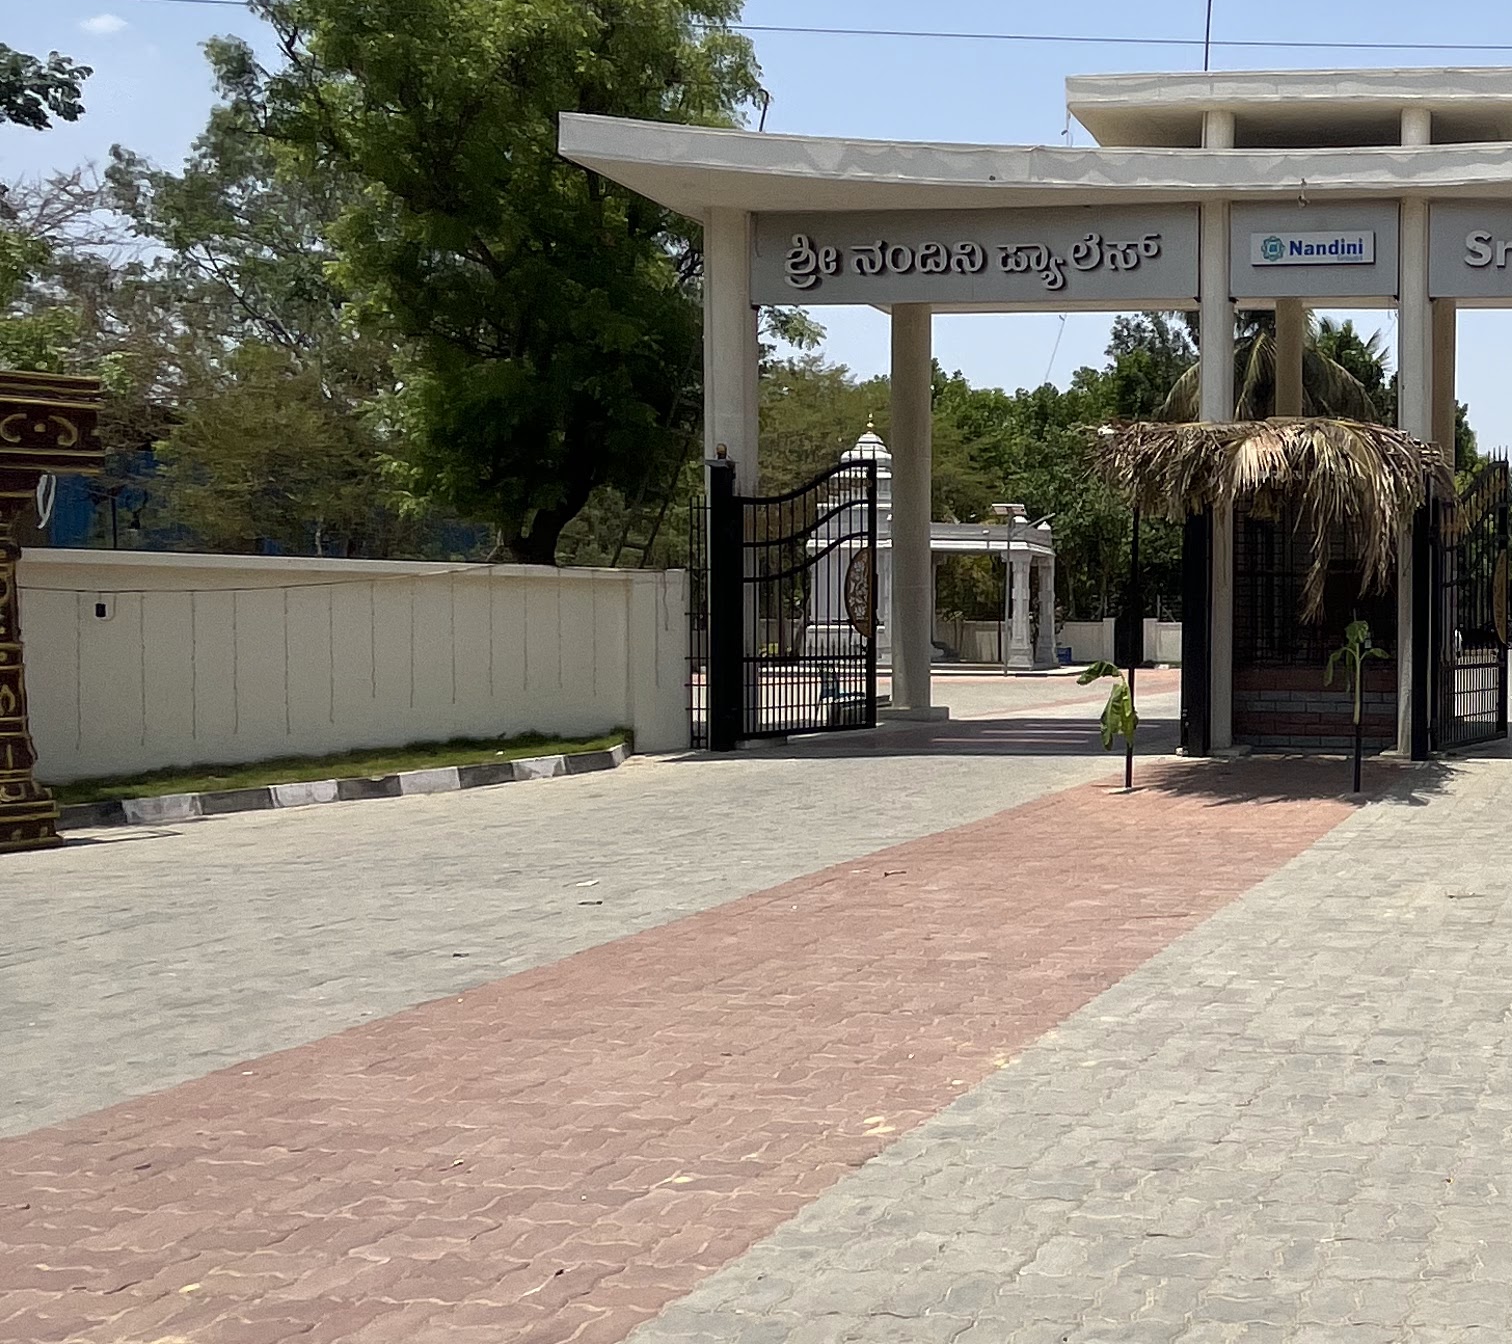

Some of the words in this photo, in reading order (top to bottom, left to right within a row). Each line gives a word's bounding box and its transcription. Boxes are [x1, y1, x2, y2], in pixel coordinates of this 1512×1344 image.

[784, 233, 838, 289] ಶ್ರೀ
[850, 239, 985, 274] ನಂದಿನಿ
[1289, 238, 1363, 256] Nandini
